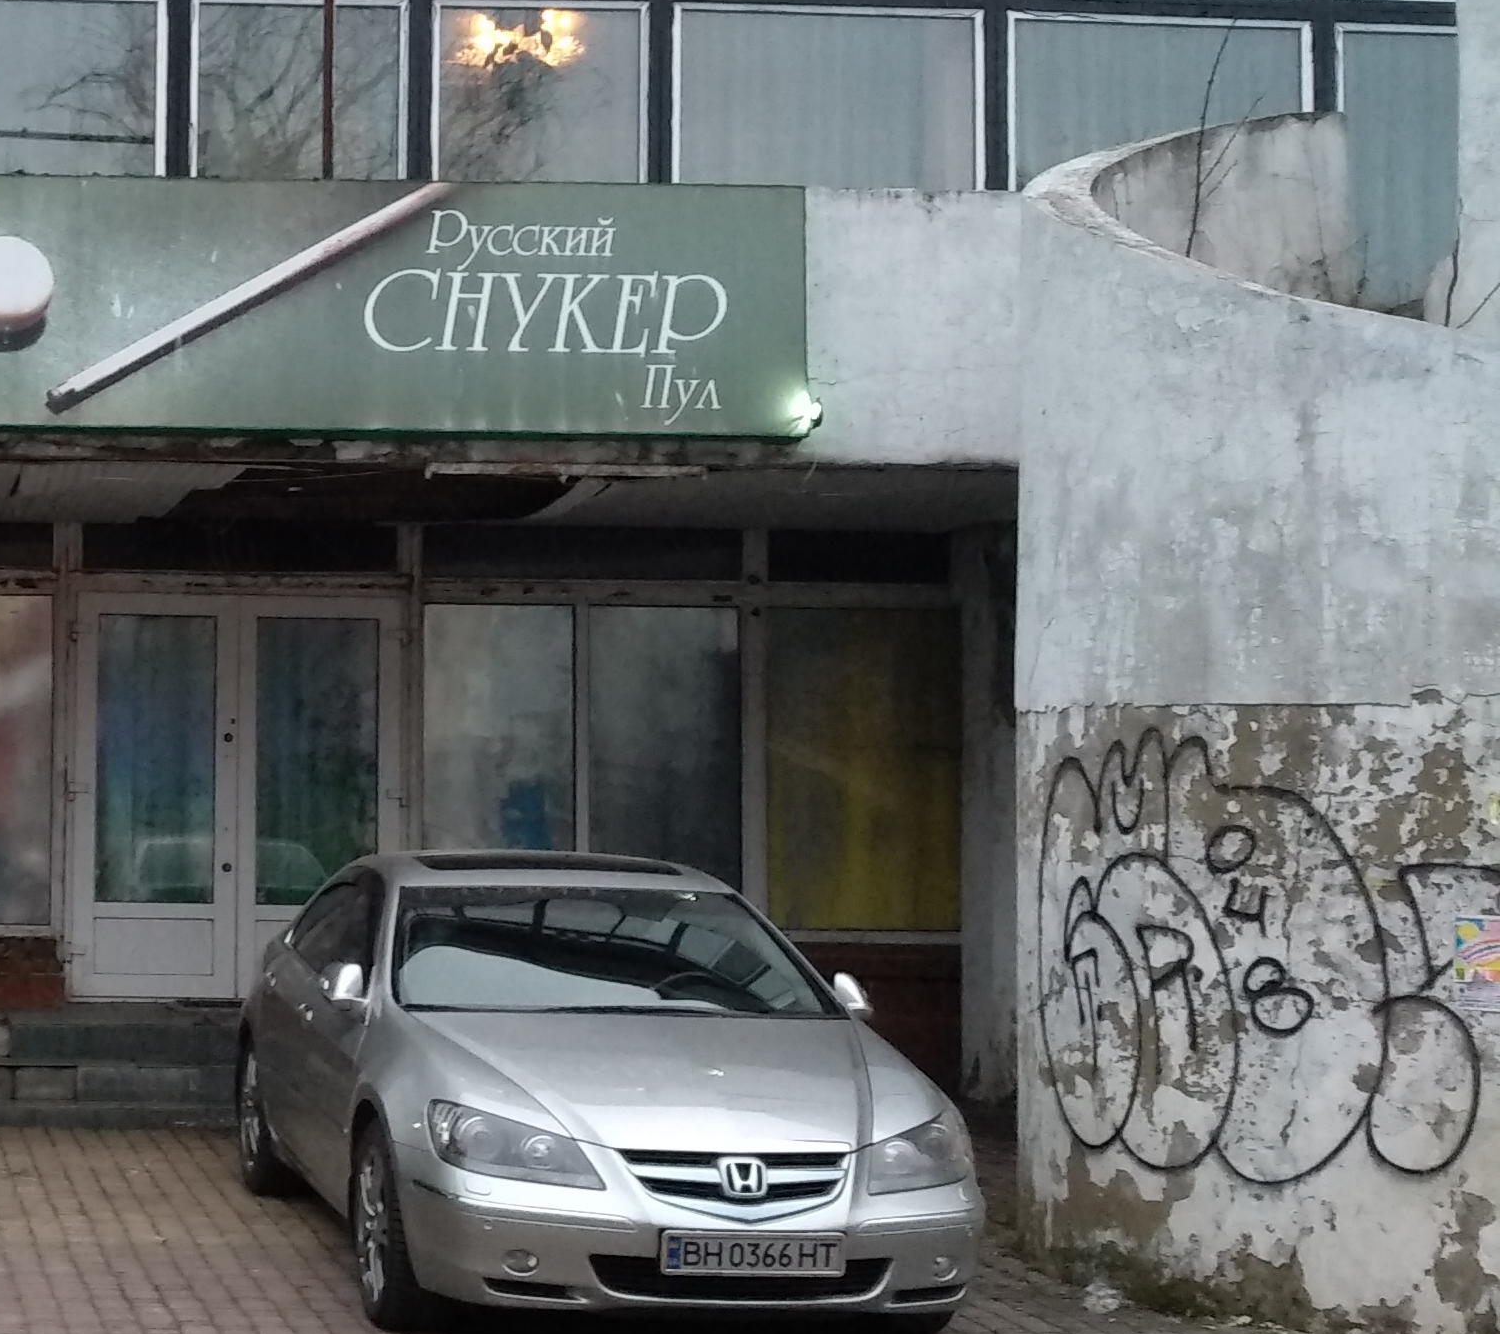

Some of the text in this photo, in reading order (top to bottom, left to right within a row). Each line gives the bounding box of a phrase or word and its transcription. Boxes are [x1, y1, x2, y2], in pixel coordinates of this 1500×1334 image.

[425, 208, 617, 270] Русский
[363, 267, 729, 358] СНУКЕР
[640, 364, 722, 426] Пул
